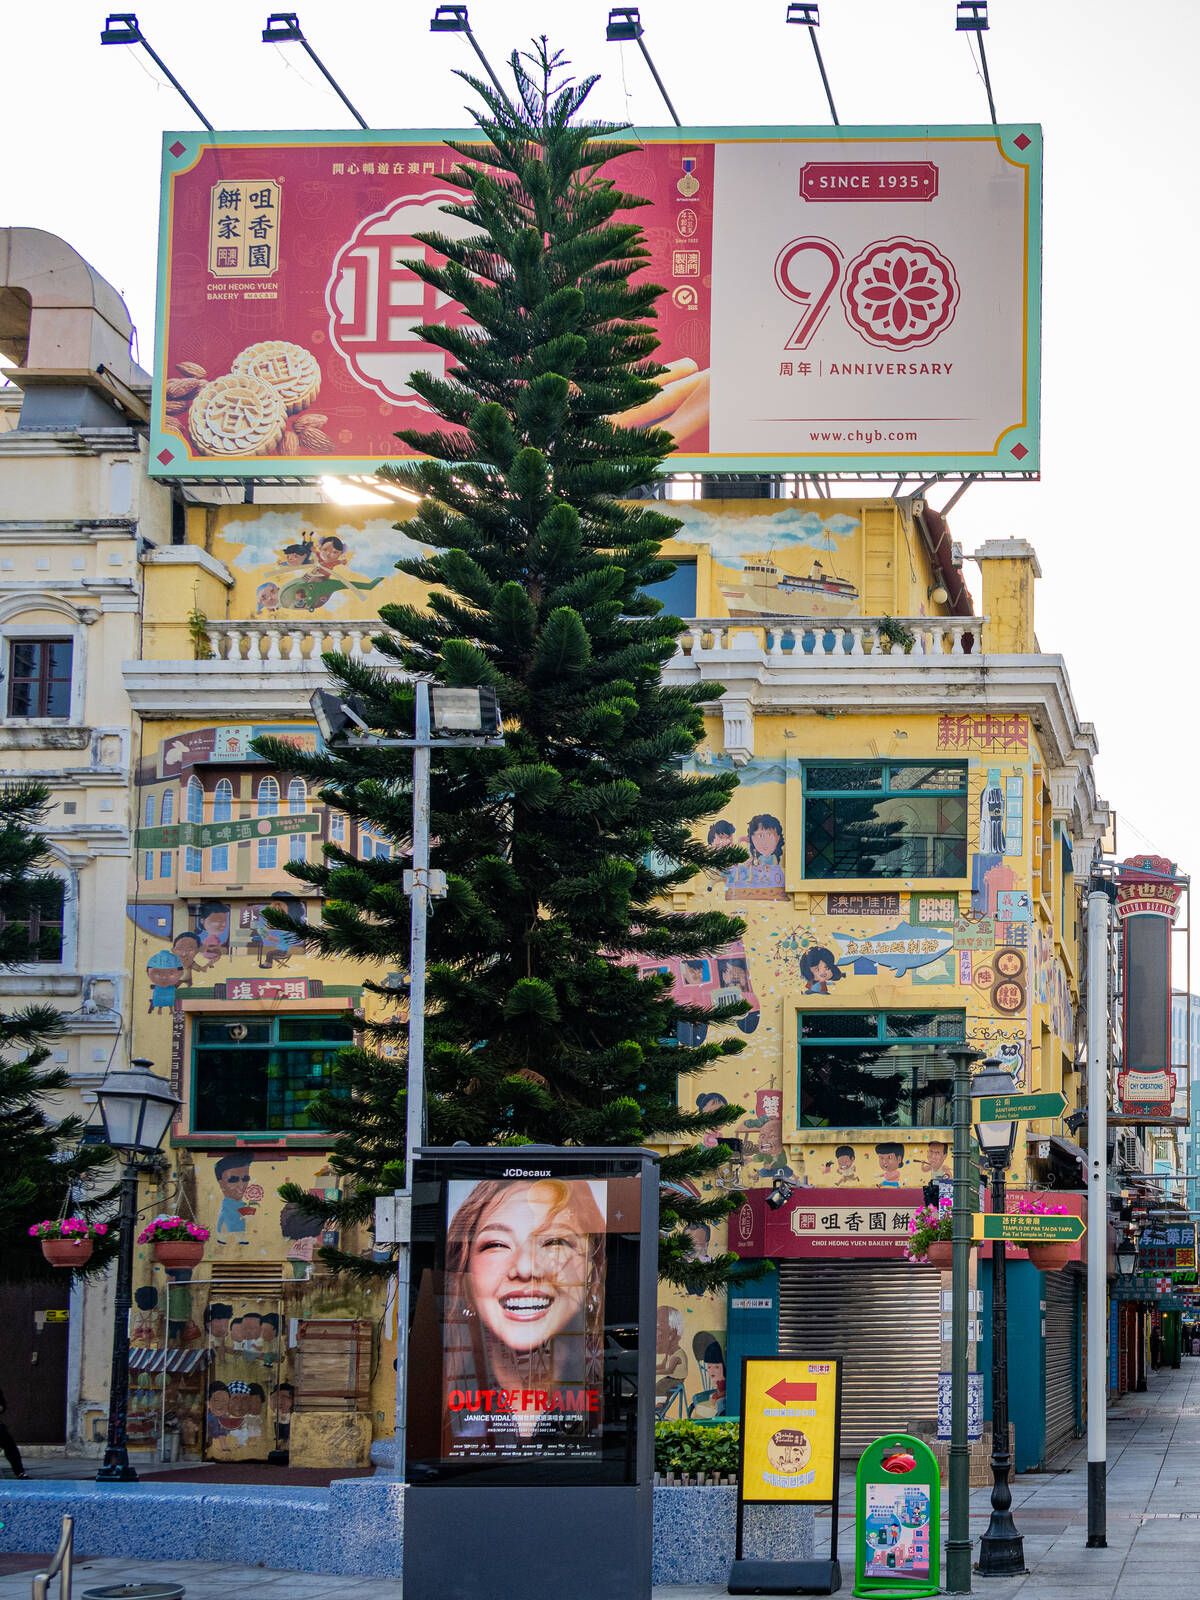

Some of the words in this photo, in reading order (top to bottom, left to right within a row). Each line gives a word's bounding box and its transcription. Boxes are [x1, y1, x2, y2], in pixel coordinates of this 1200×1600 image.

[819, 176, 870, 188] SINCE
[878, 175, 919, 188] 1935
[258, 282, 279, 290] YUEN
[779, 361, 812, 376] 周年
[829, 362, 954, 375] ANNIVERSARY
[809, 428, 918, 445] www.chyb.com
[939, 714, 1029, 748] 新中央
[832, 896, 896, 908] 澳門佳作
[502, 1168, 552, 1178] JCDecaux
[447, 1390, 496, 1412] OUT
[496, 1389, 520, 1410] OF
[520, 1390, 599, 1411] FRAME
